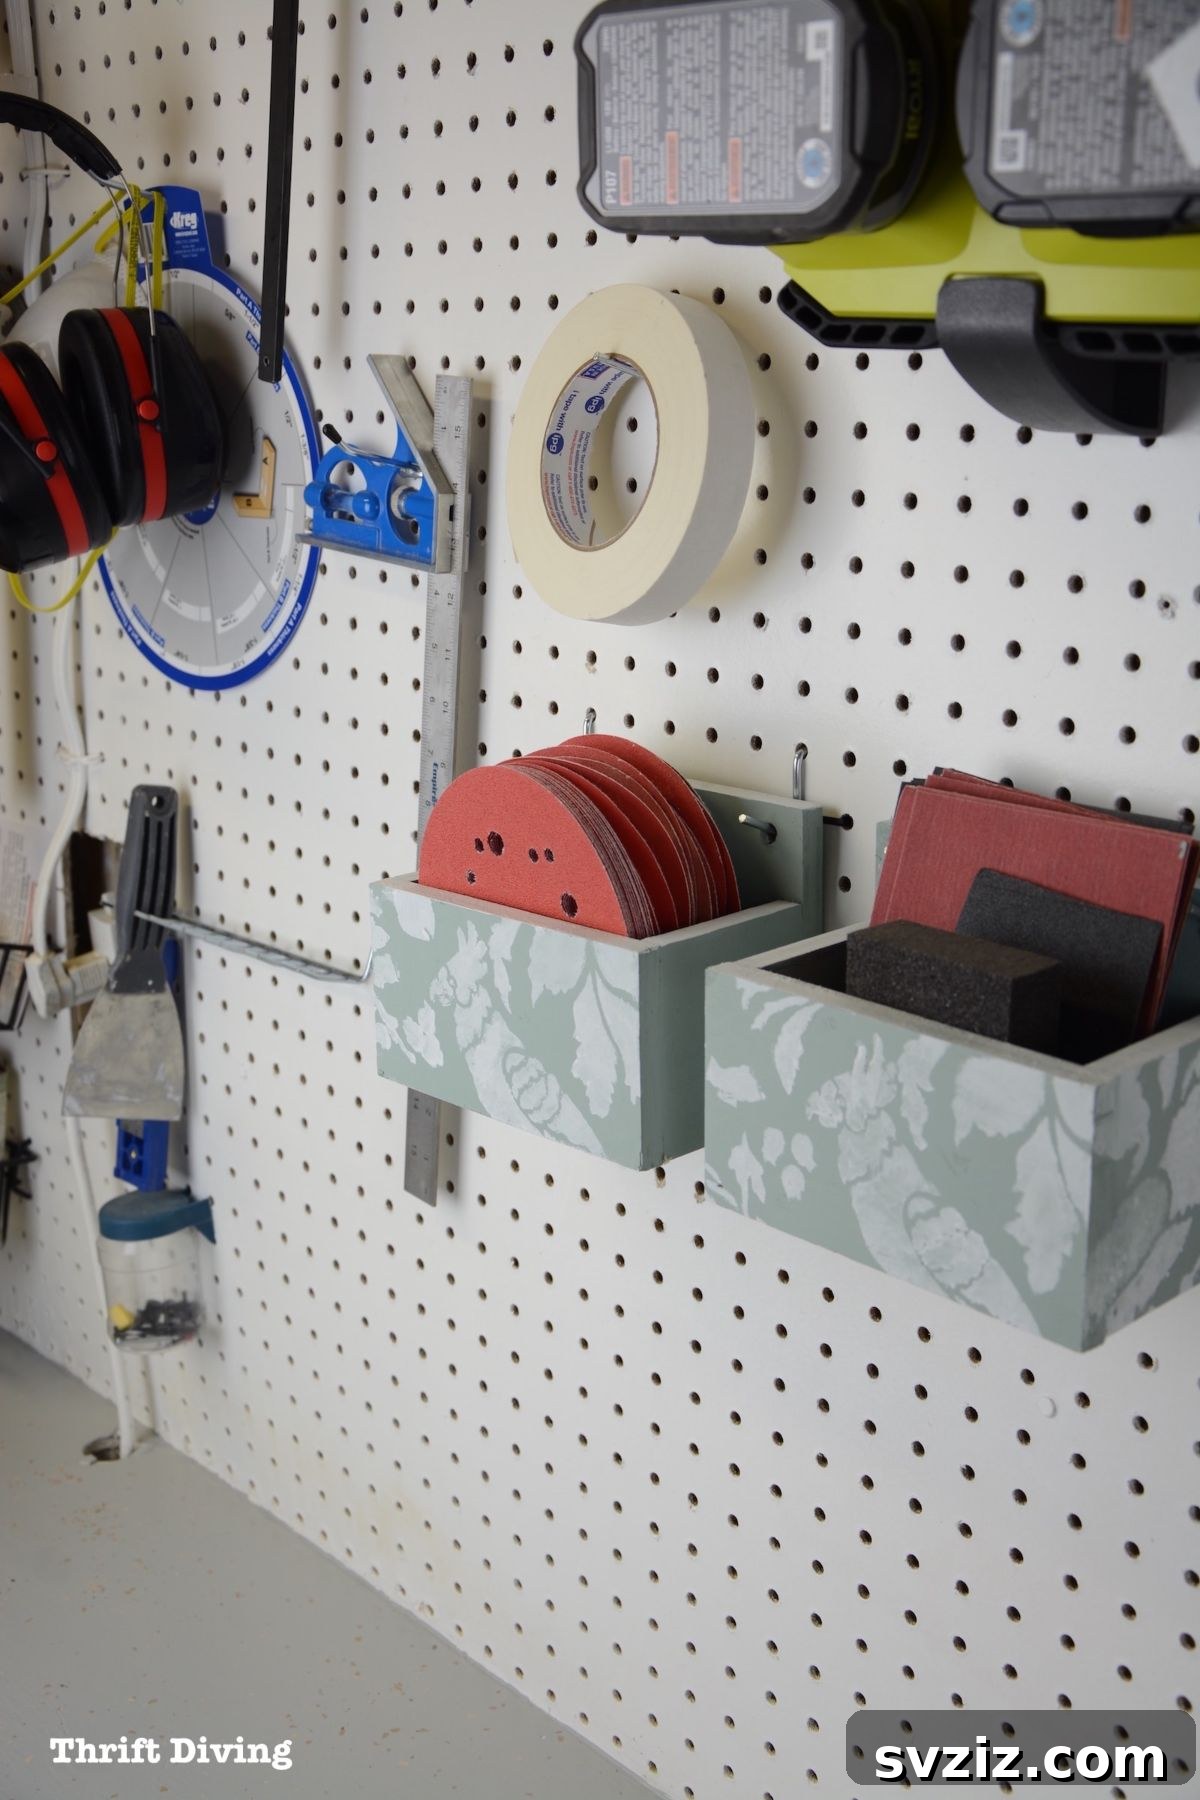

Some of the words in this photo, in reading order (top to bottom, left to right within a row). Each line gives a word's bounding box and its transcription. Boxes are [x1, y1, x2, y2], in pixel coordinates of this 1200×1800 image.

[171, 211, 198, 229] Kreg
[562, 393, 577, 412] tape
[555, 411, 568, 431] with
[447, 593, 454, 606] 12
[442, 701, 449, 713] 10
